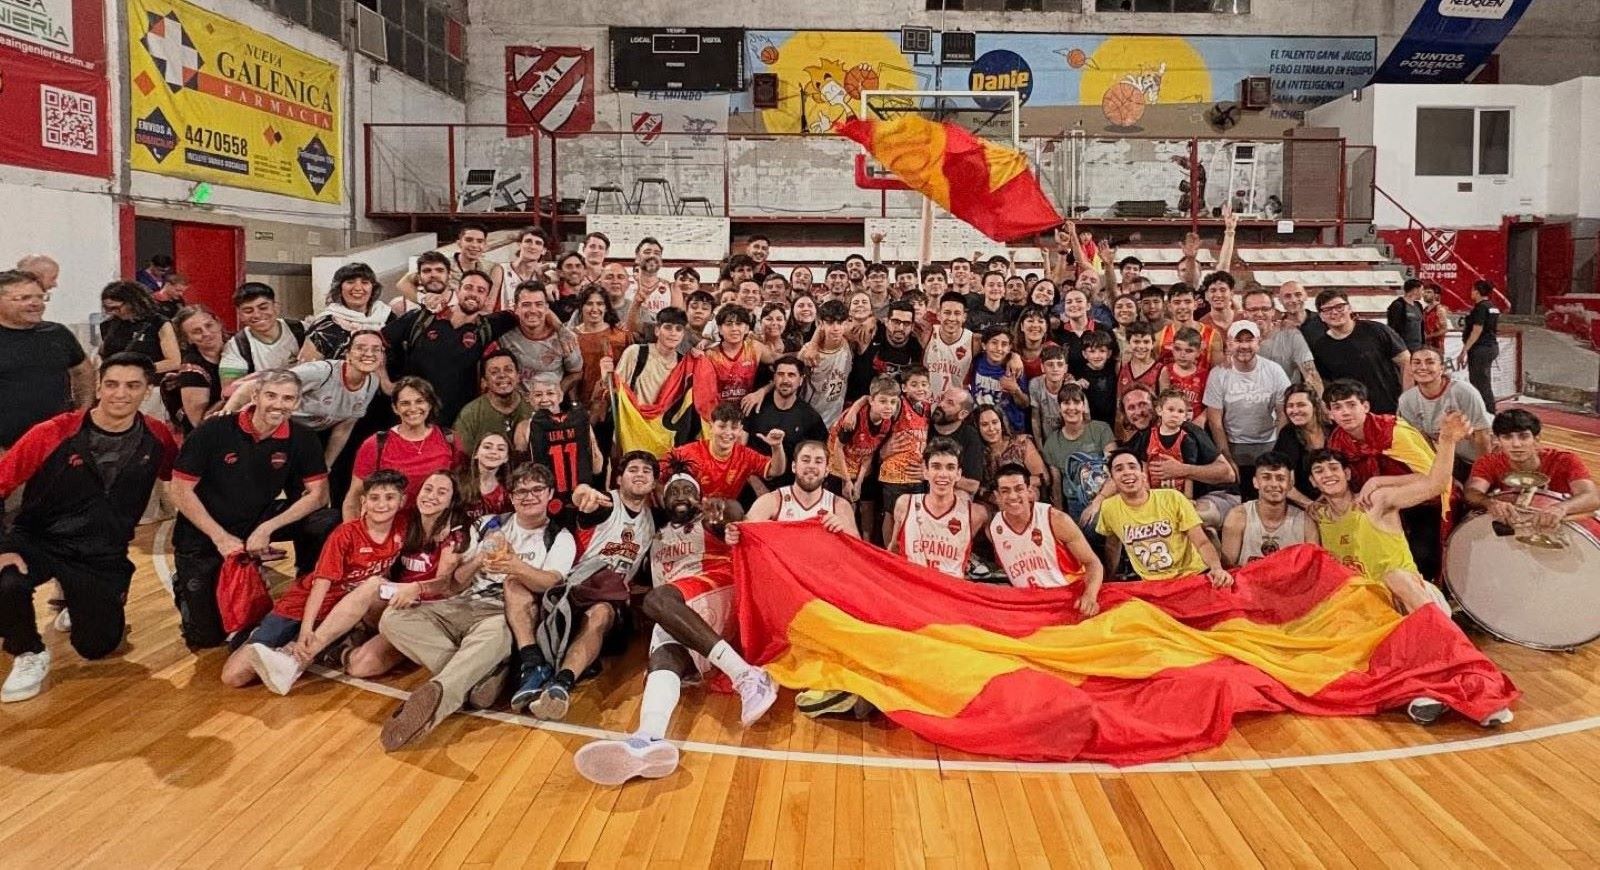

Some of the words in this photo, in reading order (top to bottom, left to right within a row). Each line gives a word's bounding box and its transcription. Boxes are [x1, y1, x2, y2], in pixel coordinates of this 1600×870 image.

[245, 43, 281, 67] NUEVA
[1281, 49, 1315, 60] TALENTO
[1342, 50, 1372, 61] JUEGOS
[1400, 60, 1464, 69] PODEMOS
[1411, 52, 1464, 60] JUNTOS
[1269, 64, 1293, 74] PERO
[217, 51, 333, 112] GALENICA
[972, 70, 1030, 91] Dante
[1288, 79, 1344, 90] INTELIGENCIA
[224, 84, 330, 128] FARMACIA
[185, 125, 248, 157] 4470558
[829, 381, 842, 396] 23
[943, 375, 949, 391] 7
[548, 442, 577, 493] 11
[1123, 519, 1173, 544] LAKERS
[1133, 541, 1173, 571] 23
